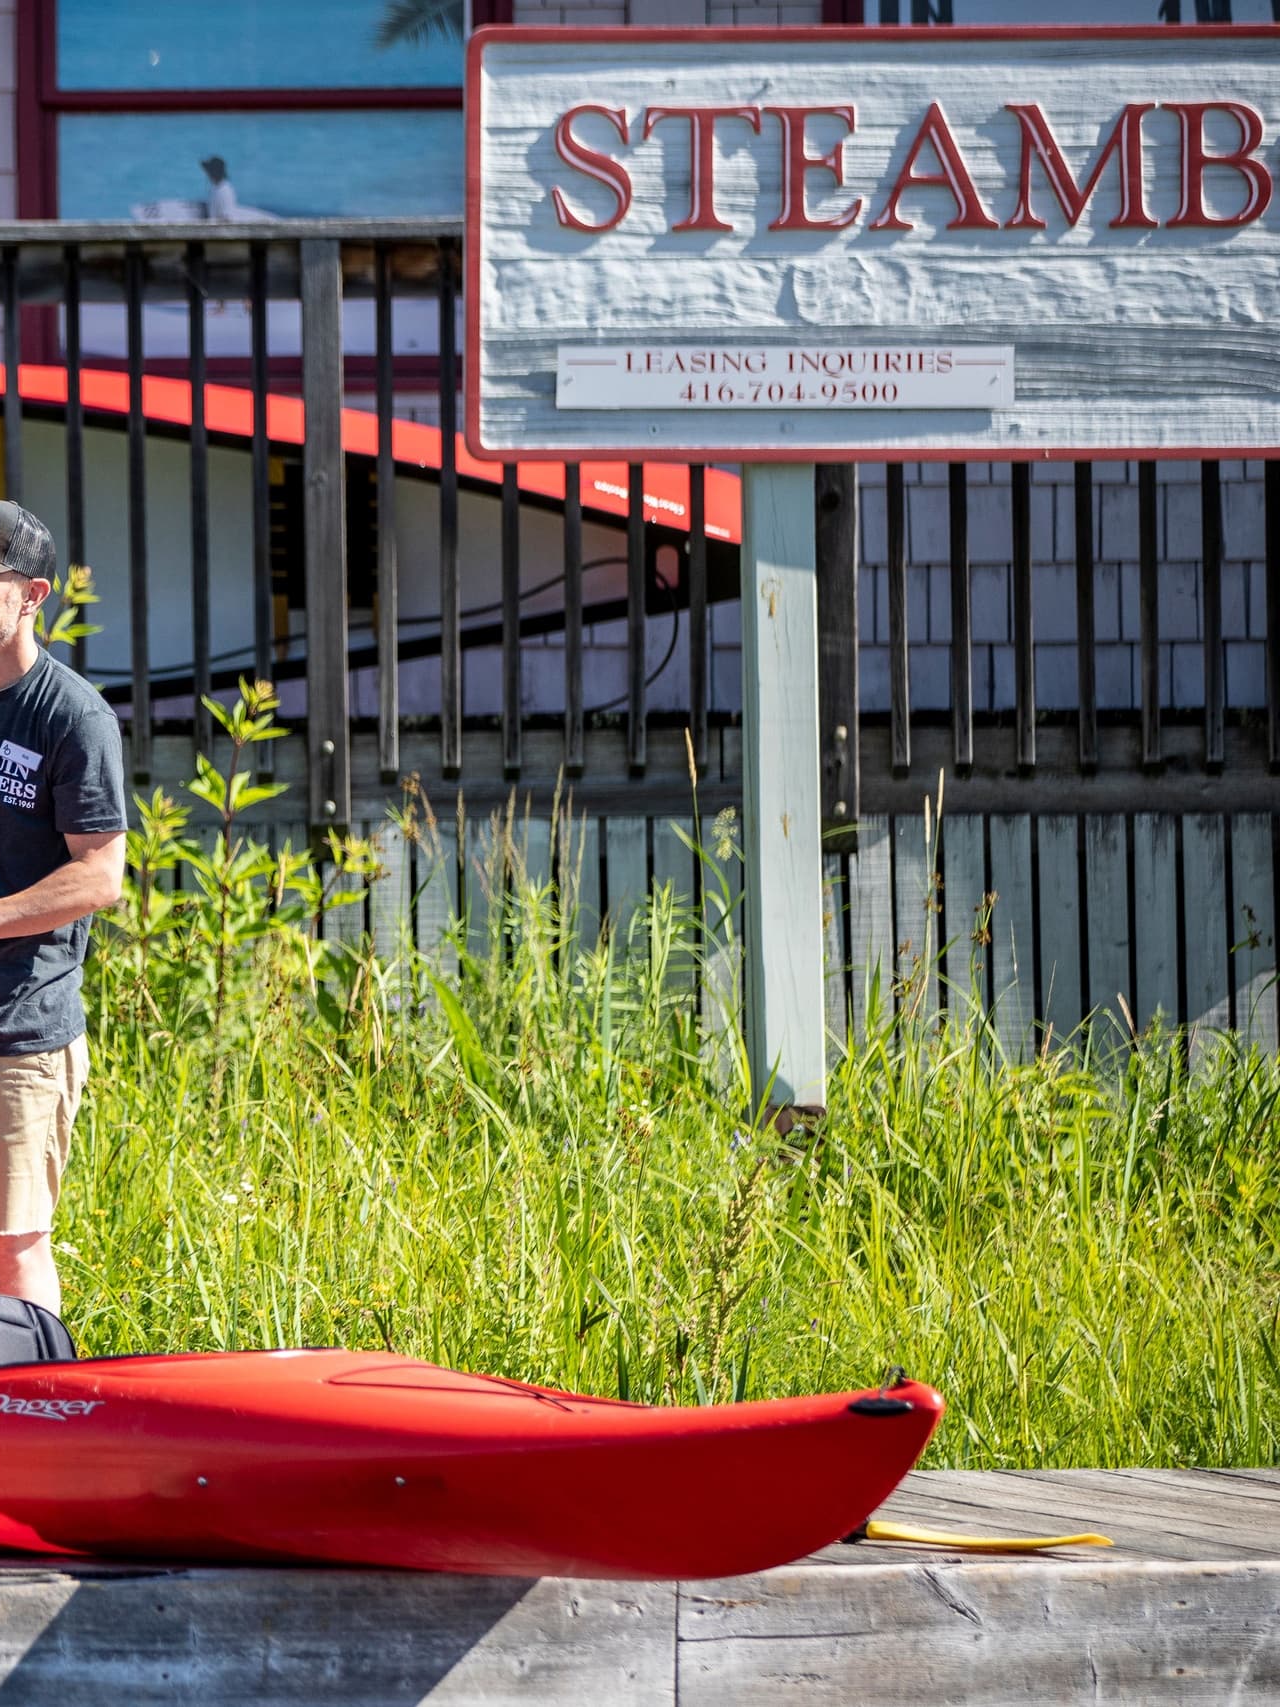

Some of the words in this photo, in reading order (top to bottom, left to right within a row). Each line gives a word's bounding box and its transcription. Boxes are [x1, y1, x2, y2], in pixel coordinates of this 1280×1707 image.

[551, 102, 1273, 232] STEAMB
[624, 352, 768, 374] LEASING
[786, 352, 954, 378] INQUIRIES
[679, 381, 899, 404] 416-704-9500
[3, 795, 18, 806] EST.
[19, 799, 35, 809] 1961
